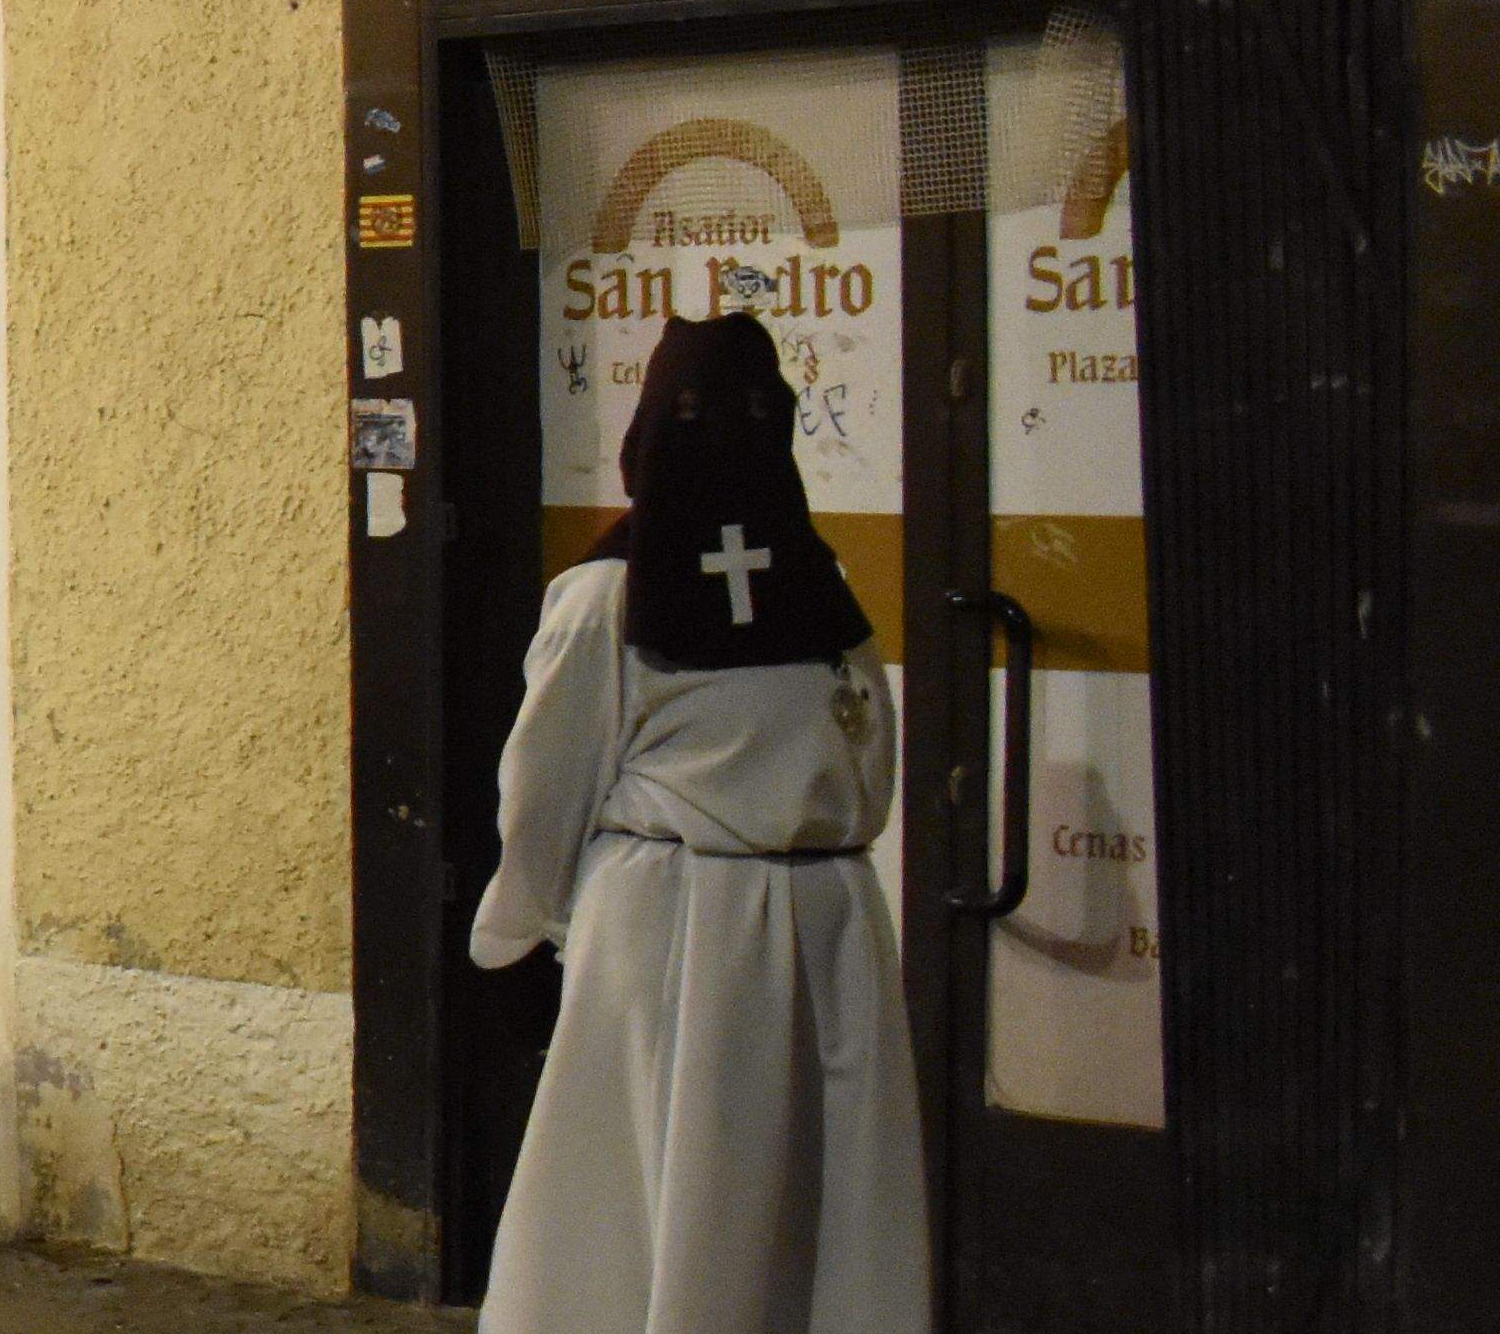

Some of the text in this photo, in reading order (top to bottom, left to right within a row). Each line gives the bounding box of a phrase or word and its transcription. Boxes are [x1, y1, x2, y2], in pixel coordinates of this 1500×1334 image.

[652, 210, 775, 247] Asador
[562, 254, 874, 320] San Pdro
[1049, 350, 1139, 384] Plaza
[1052, 824, 1148, 862] Cenas
